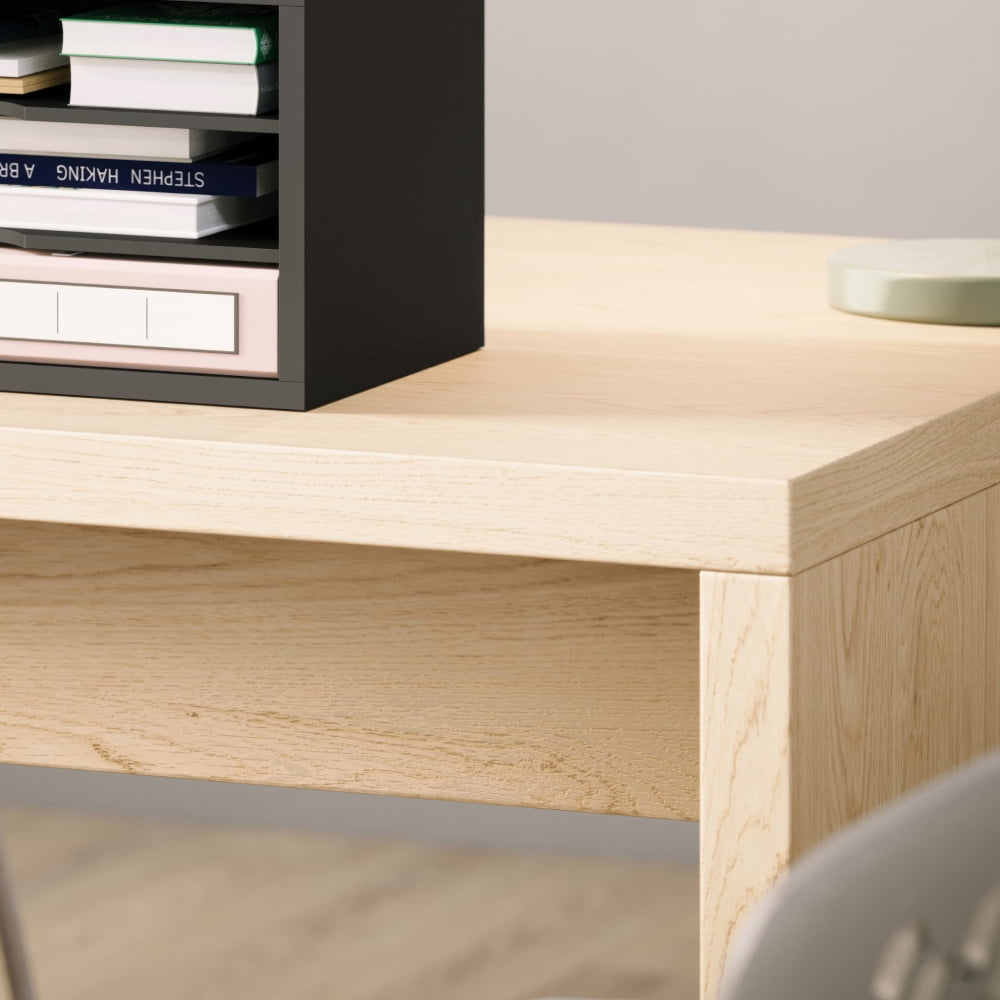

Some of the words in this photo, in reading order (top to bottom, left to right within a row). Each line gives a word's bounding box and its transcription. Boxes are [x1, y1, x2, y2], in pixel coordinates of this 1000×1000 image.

[24, 163, 36, 178] A
[56, 164, 119, 184] HAKING
[131, 169, 205, 188] STEPHEN
